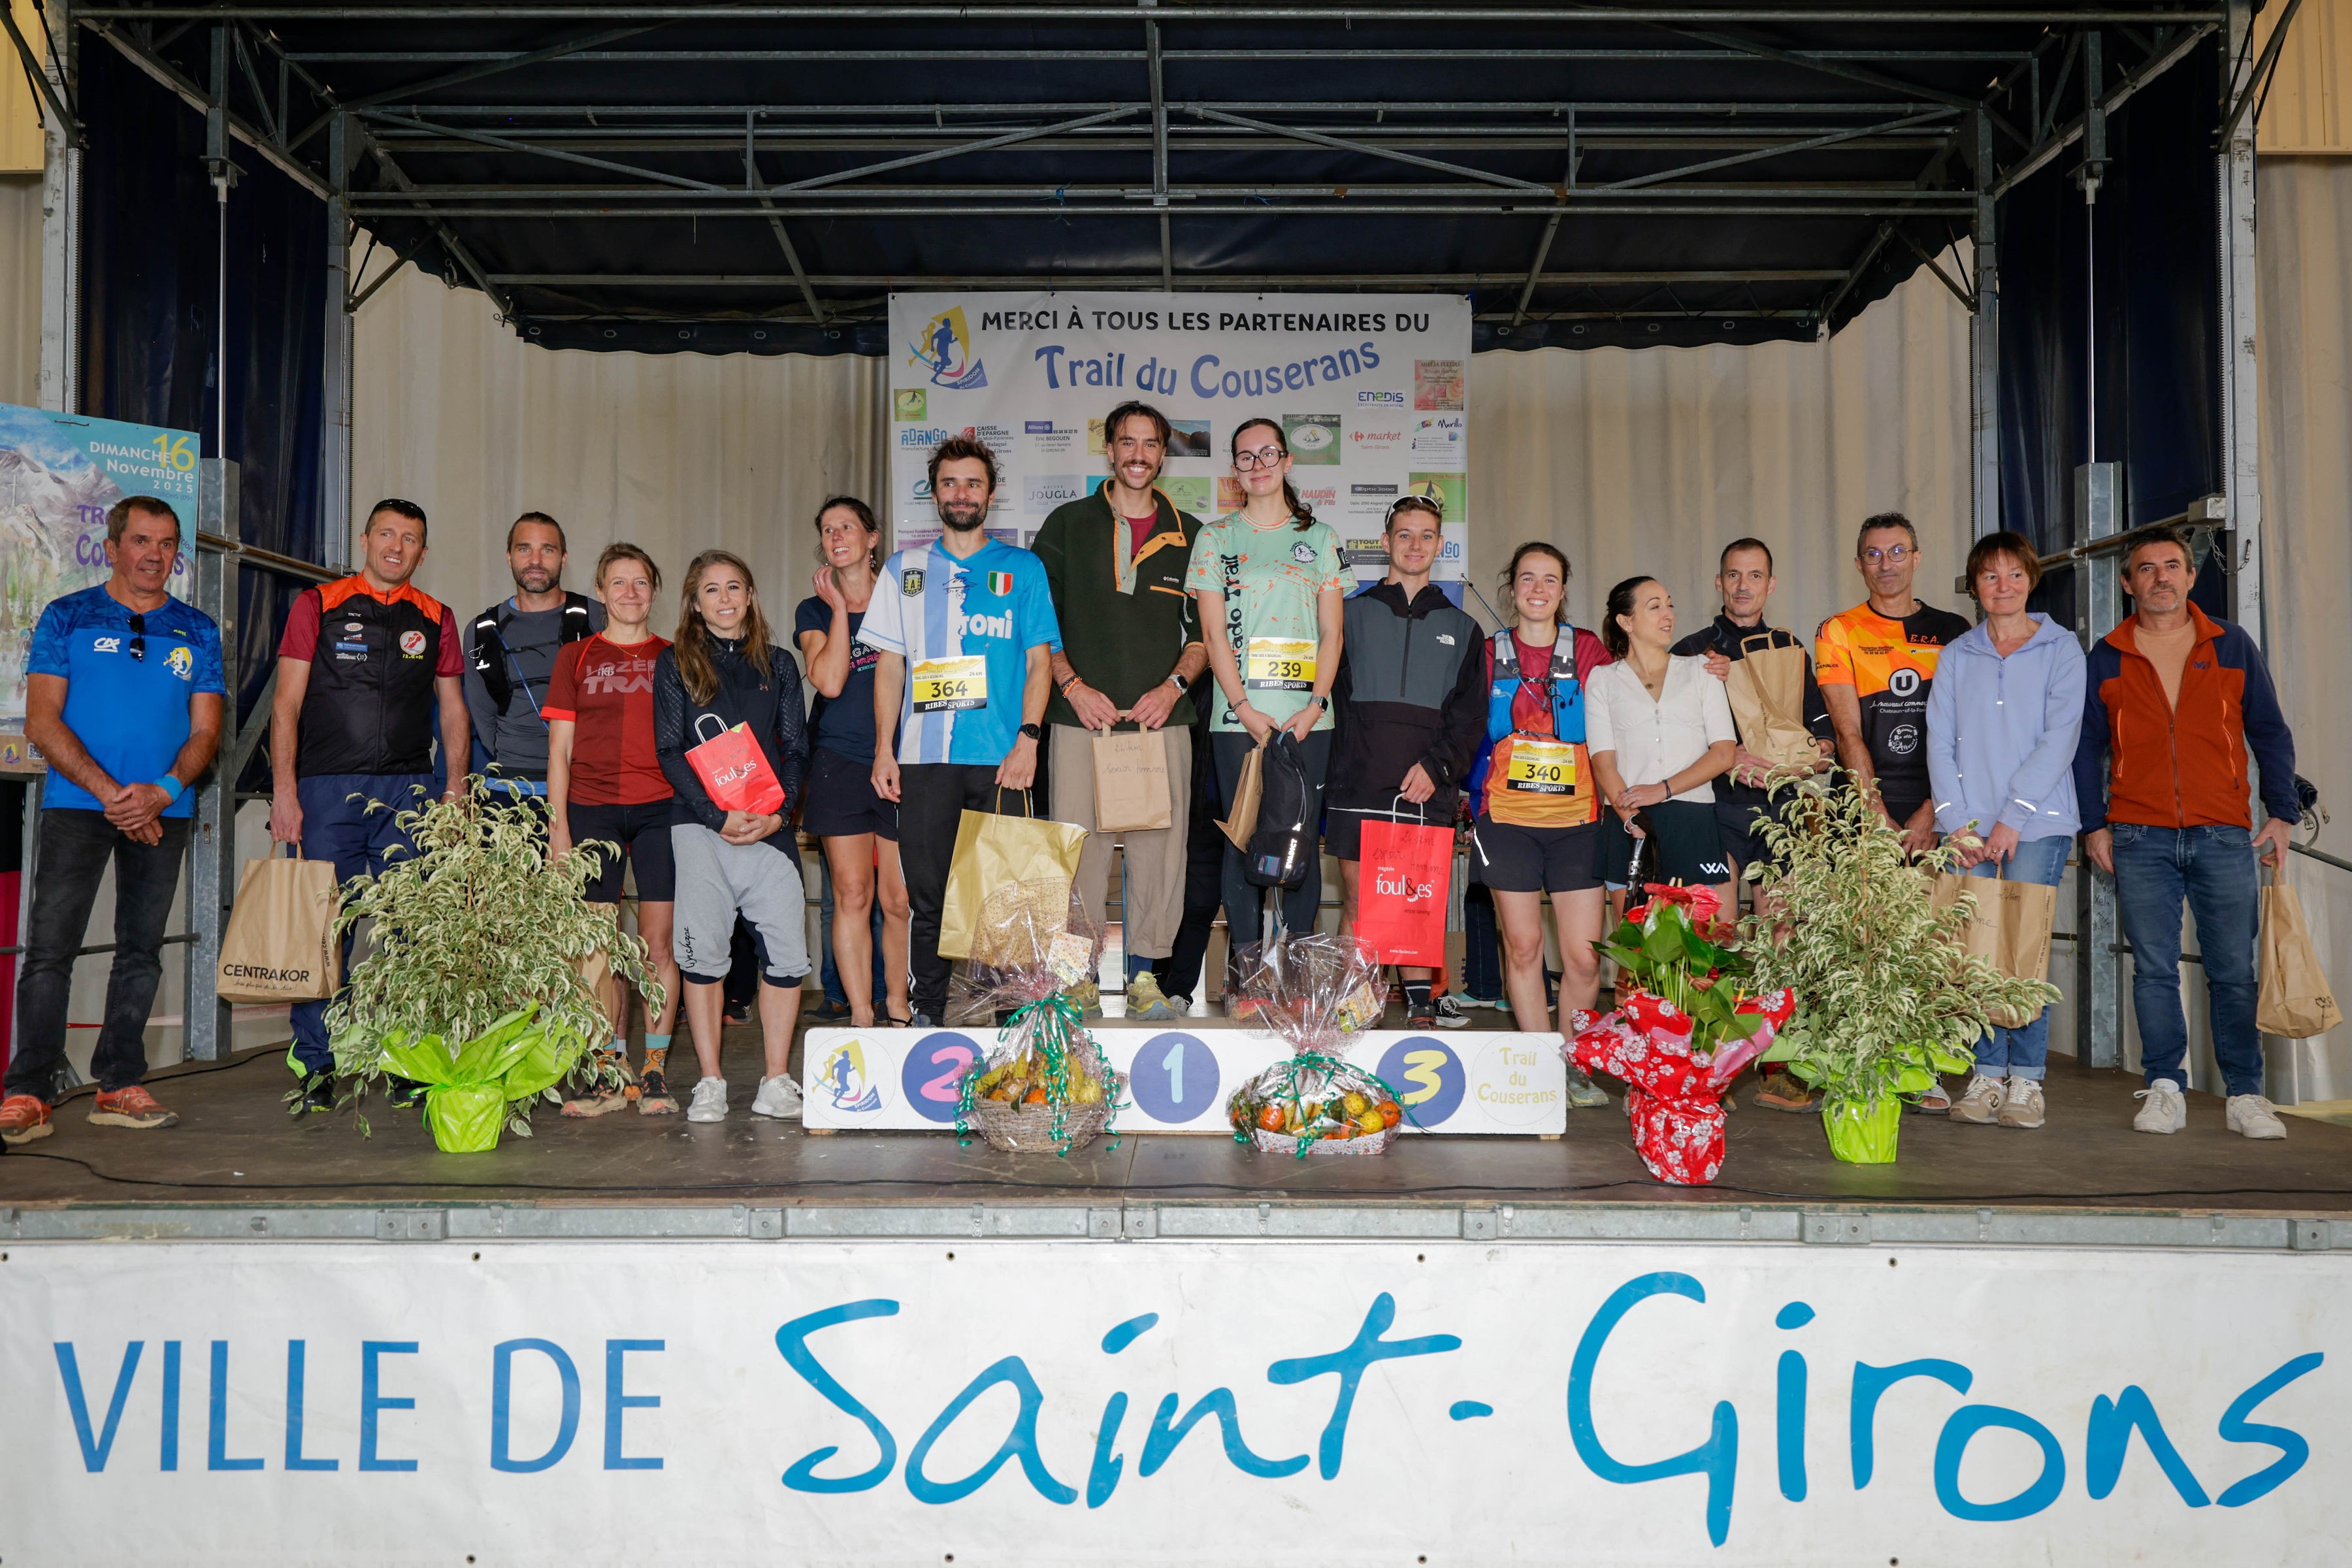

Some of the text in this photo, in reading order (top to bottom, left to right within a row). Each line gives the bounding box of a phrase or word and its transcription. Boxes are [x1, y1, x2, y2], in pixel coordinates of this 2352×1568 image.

[982, 305, 1429, 333] MERCI À TOUS LES PARTENAIRES DU
[956, 367, 981, 385] SPIRIDON
[1035, 342, 1380, 399] Trail du Couserans
[1438, 418, 1462, 429] Murillo
[1367, 431, 1401, 442] market
[90, 433, 195, 471] DIMANCHE 16
[107, 459, 195, 482] Novembre
[135, 489, 179, 500] SAINT-GIRONS
[153, 481, 194, 493] 2025
[1028, 490, 1077, 501] JOUGLA
[1301, 489, 1335, 498] NAUDIN
[1220, 554, 1241, 601] Trail
[1910, 634, 1940, 644] B.R.A.
[1268, 661, 1301, 678] 239
[931, 681, 968, 698] 364
[1896, 674, 1912, 691] U
[925, 698, 975, 710] RIBES SPORTS
[1526, 764, 1560, 781] 340
[223, 964, 310, 982] CENTRAKOR
[1499, 1047, 1537, 1066] Trail
[920, 1046, 973, 1102] 2
[1162, 1043, 1184, 1103] 1
[1403, 1049, 1448, 1105] 3
[1509, 1071, 1527, 1086] du
[1477, 1083, 1558, 1104] Couserans
[52, 1339, 419, 1473] VILLE
[489, 1339, 665, 1473] DE
